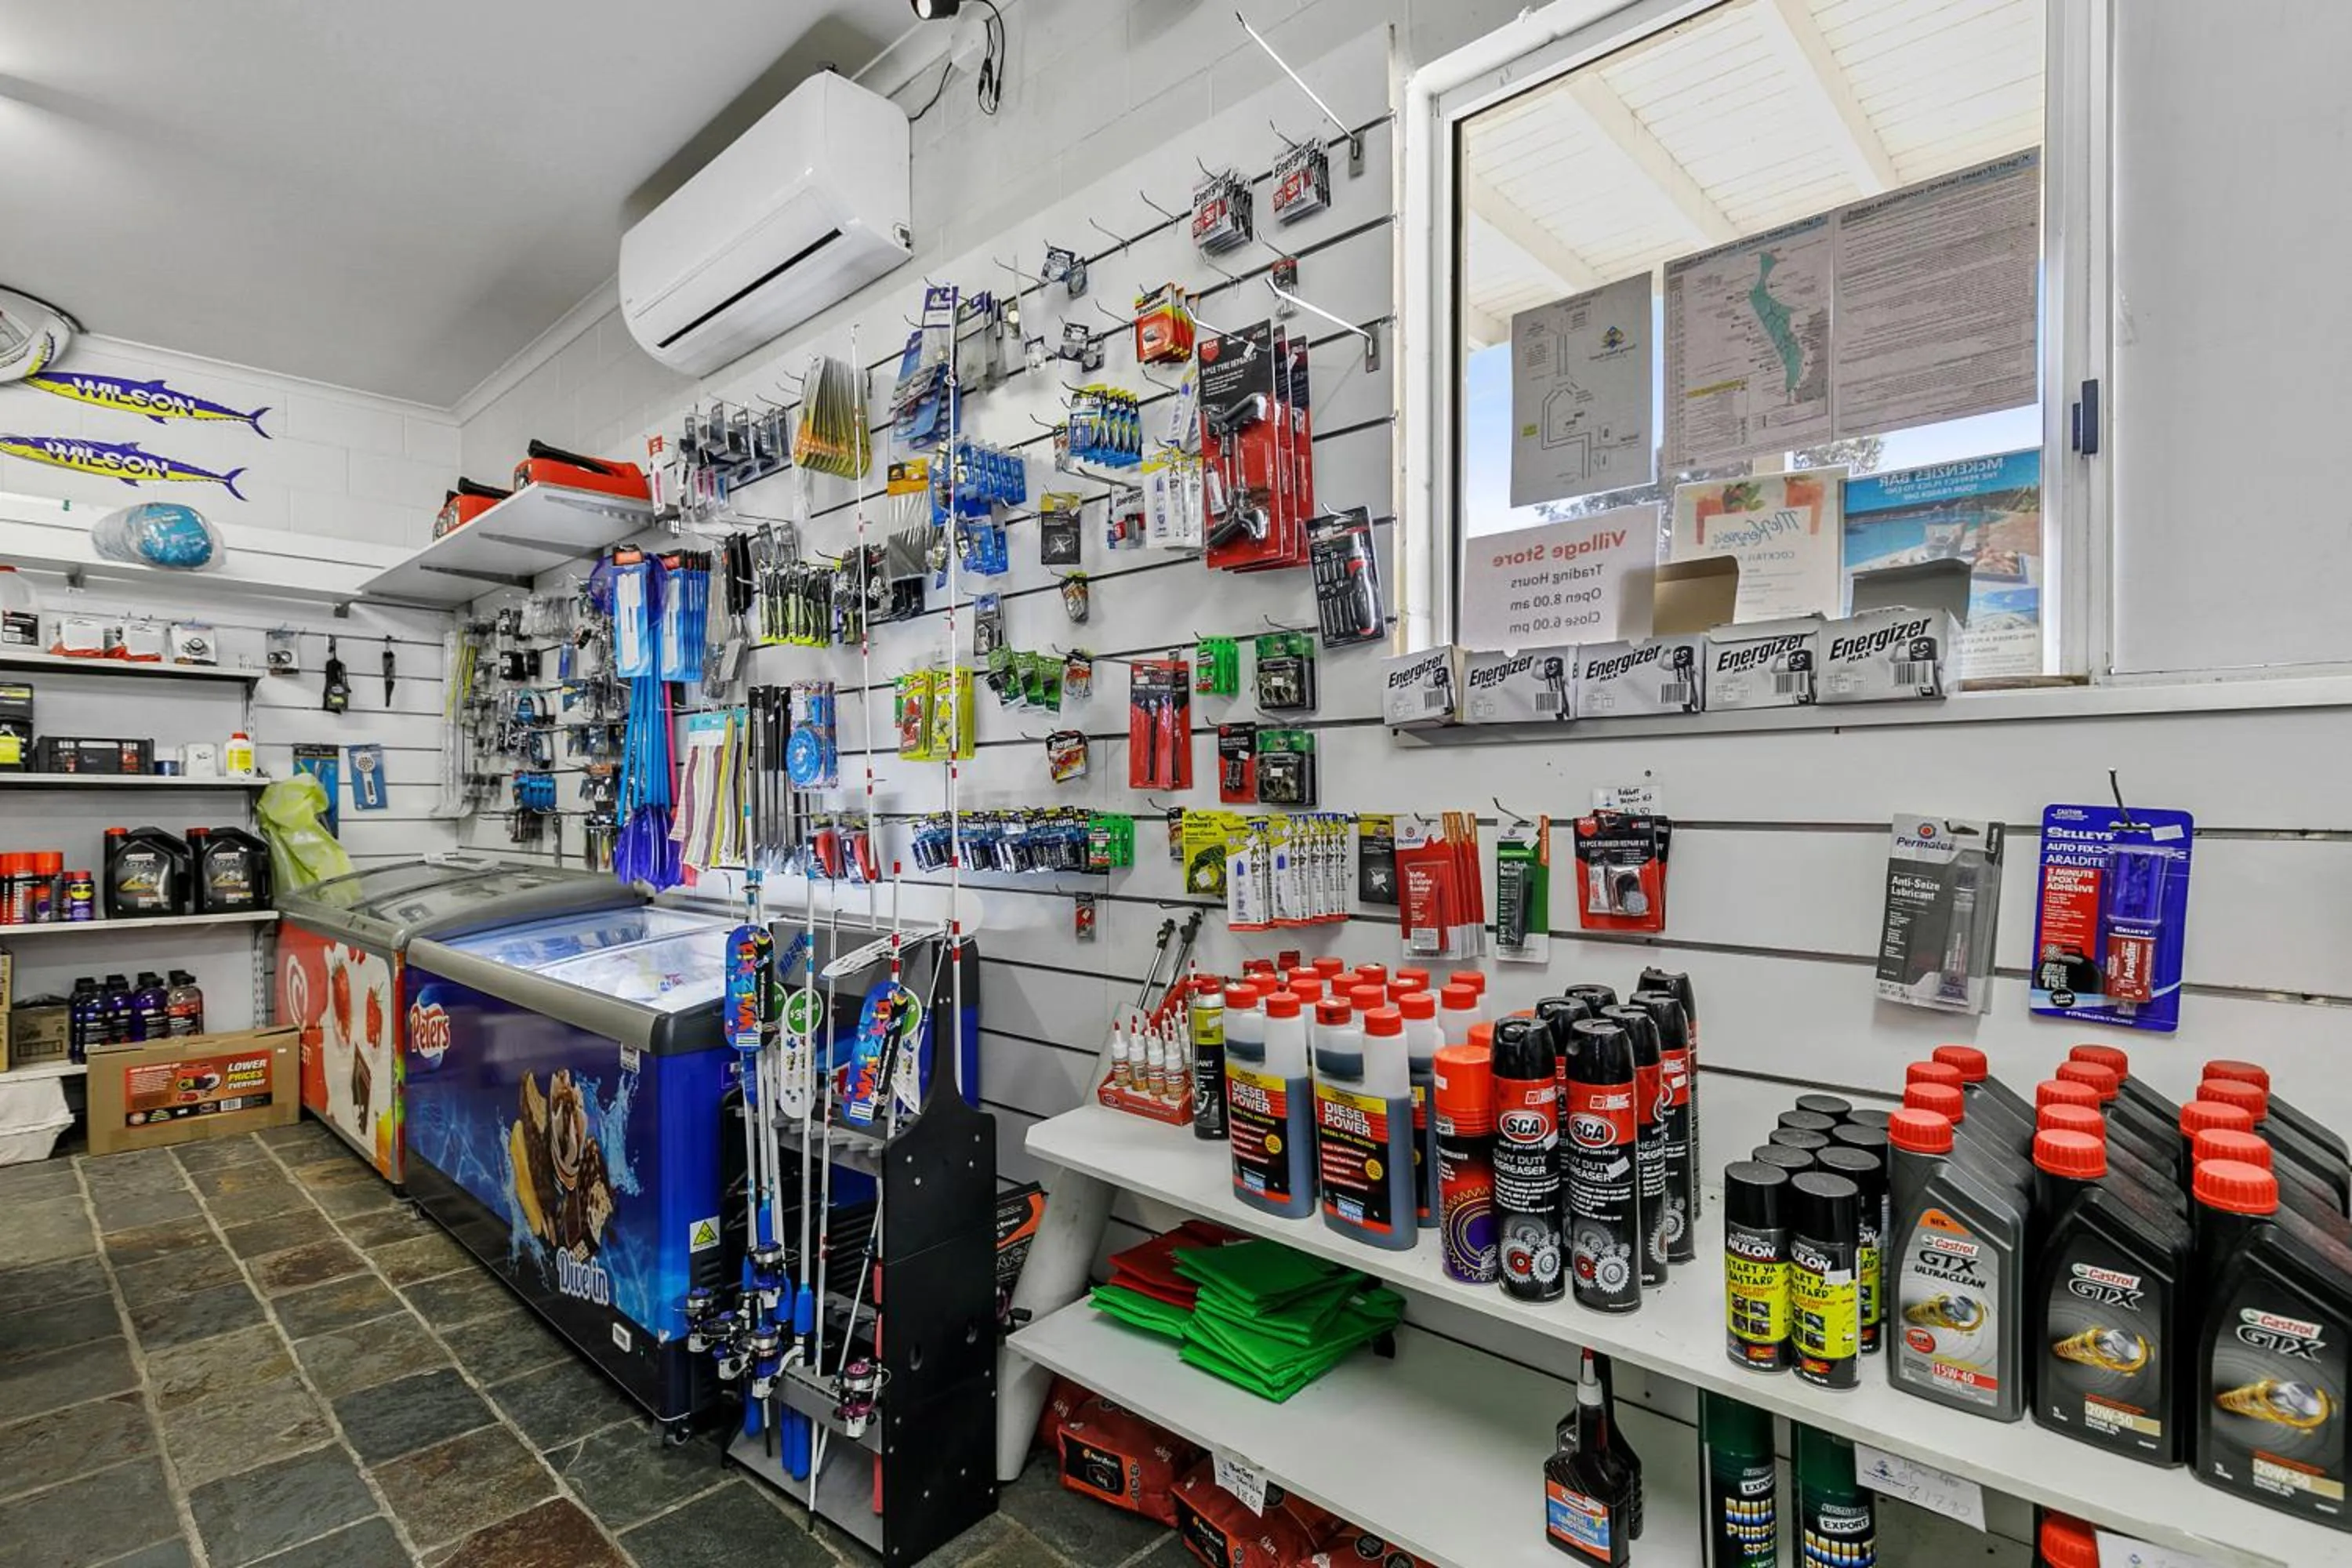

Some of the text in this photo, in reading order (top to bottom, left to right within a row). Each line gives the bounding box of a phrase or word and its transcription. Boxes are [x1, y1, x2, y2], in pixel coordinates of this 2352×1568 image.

[71, 376, 195, 418] WILSON
[43, 441, 169, 479] WILSON
[1829, 618, 1931, 661] Energizer
[1586, 644, 1662, 679] Energizer
[1716, 633, 1804, 673] Energizer
[1847, 652, 1871, 663] MAX
[1388, 653, 1444, 688] Energizer
[1468, 654, 1534, 688] Energizer
[1733, 663, 1755, 674] MAX
[1599, 673, 1618, 684] MAX
[2056, 808, 2083, 816] CAUTION
[2046, 826, 2114, 841] SELLEYS
[1896, 836, 1956, 852] Permatex
[2046, 843, 2094, 854] AUTO FIX
[2045, 855, 2105, 867] ARALDITE
[2046, 875, 2080, 884] EPOXY
[2056, 869, 2095, 879] MINUTE
[1891, 876, 1940, 892] Anti-Seize
[2045, 883, 2094, 894] ADHESIVE
[1890, 887, 1935, 901] Lubricant
[411, 999, 452, 1053] Peters
[227, 1059, 267, 1072] LOWER
[227, 1070, 264, 1082] PRICES
[227, 1079, 266, 1090] EVERYDAY
[1232, 1081, 1267, 1101] DIESEL
[1232, 1093, 1271, 1115] POWER
[1325, 1102, 1370, 1124] DIESEL
[1325, 1113, 1371, 1137] POWER
[1506, 1117, 1541, 1135] SCA
[1573, 1120, 1606, 1141] SCA
[1517, 1156, 1546, 1167] DUTY
[1929, 1217, 1947, 1227] NEW
[1727, 1237, 1776, 1258] NULON
[1935, 1238, 1975, 1255] Castrol
[1763, 1264, 1777, 1275] YA
[1919, 1249, 1979, 1275] GTX
[557, 1247, 609, 1305] Dive in
[1914, 1264, 1986, 1290] ULTRACLEAN
[2089, 1269, 2134, 1287] Castrol
[2067, 1277, 2144, 1312] GTX
[2260, 1314, 2314, 1337] Castrol
[2237, 1325, 2326, 1363] GTX
[1934, 1362, 1975, 1385] 15W-40
[2085, 1400, 2134, 1428] 20W-50
[2256, 1459, 2310, 1489] 20W-50
[1823, 1518, 1869, 1530] EXPORT
